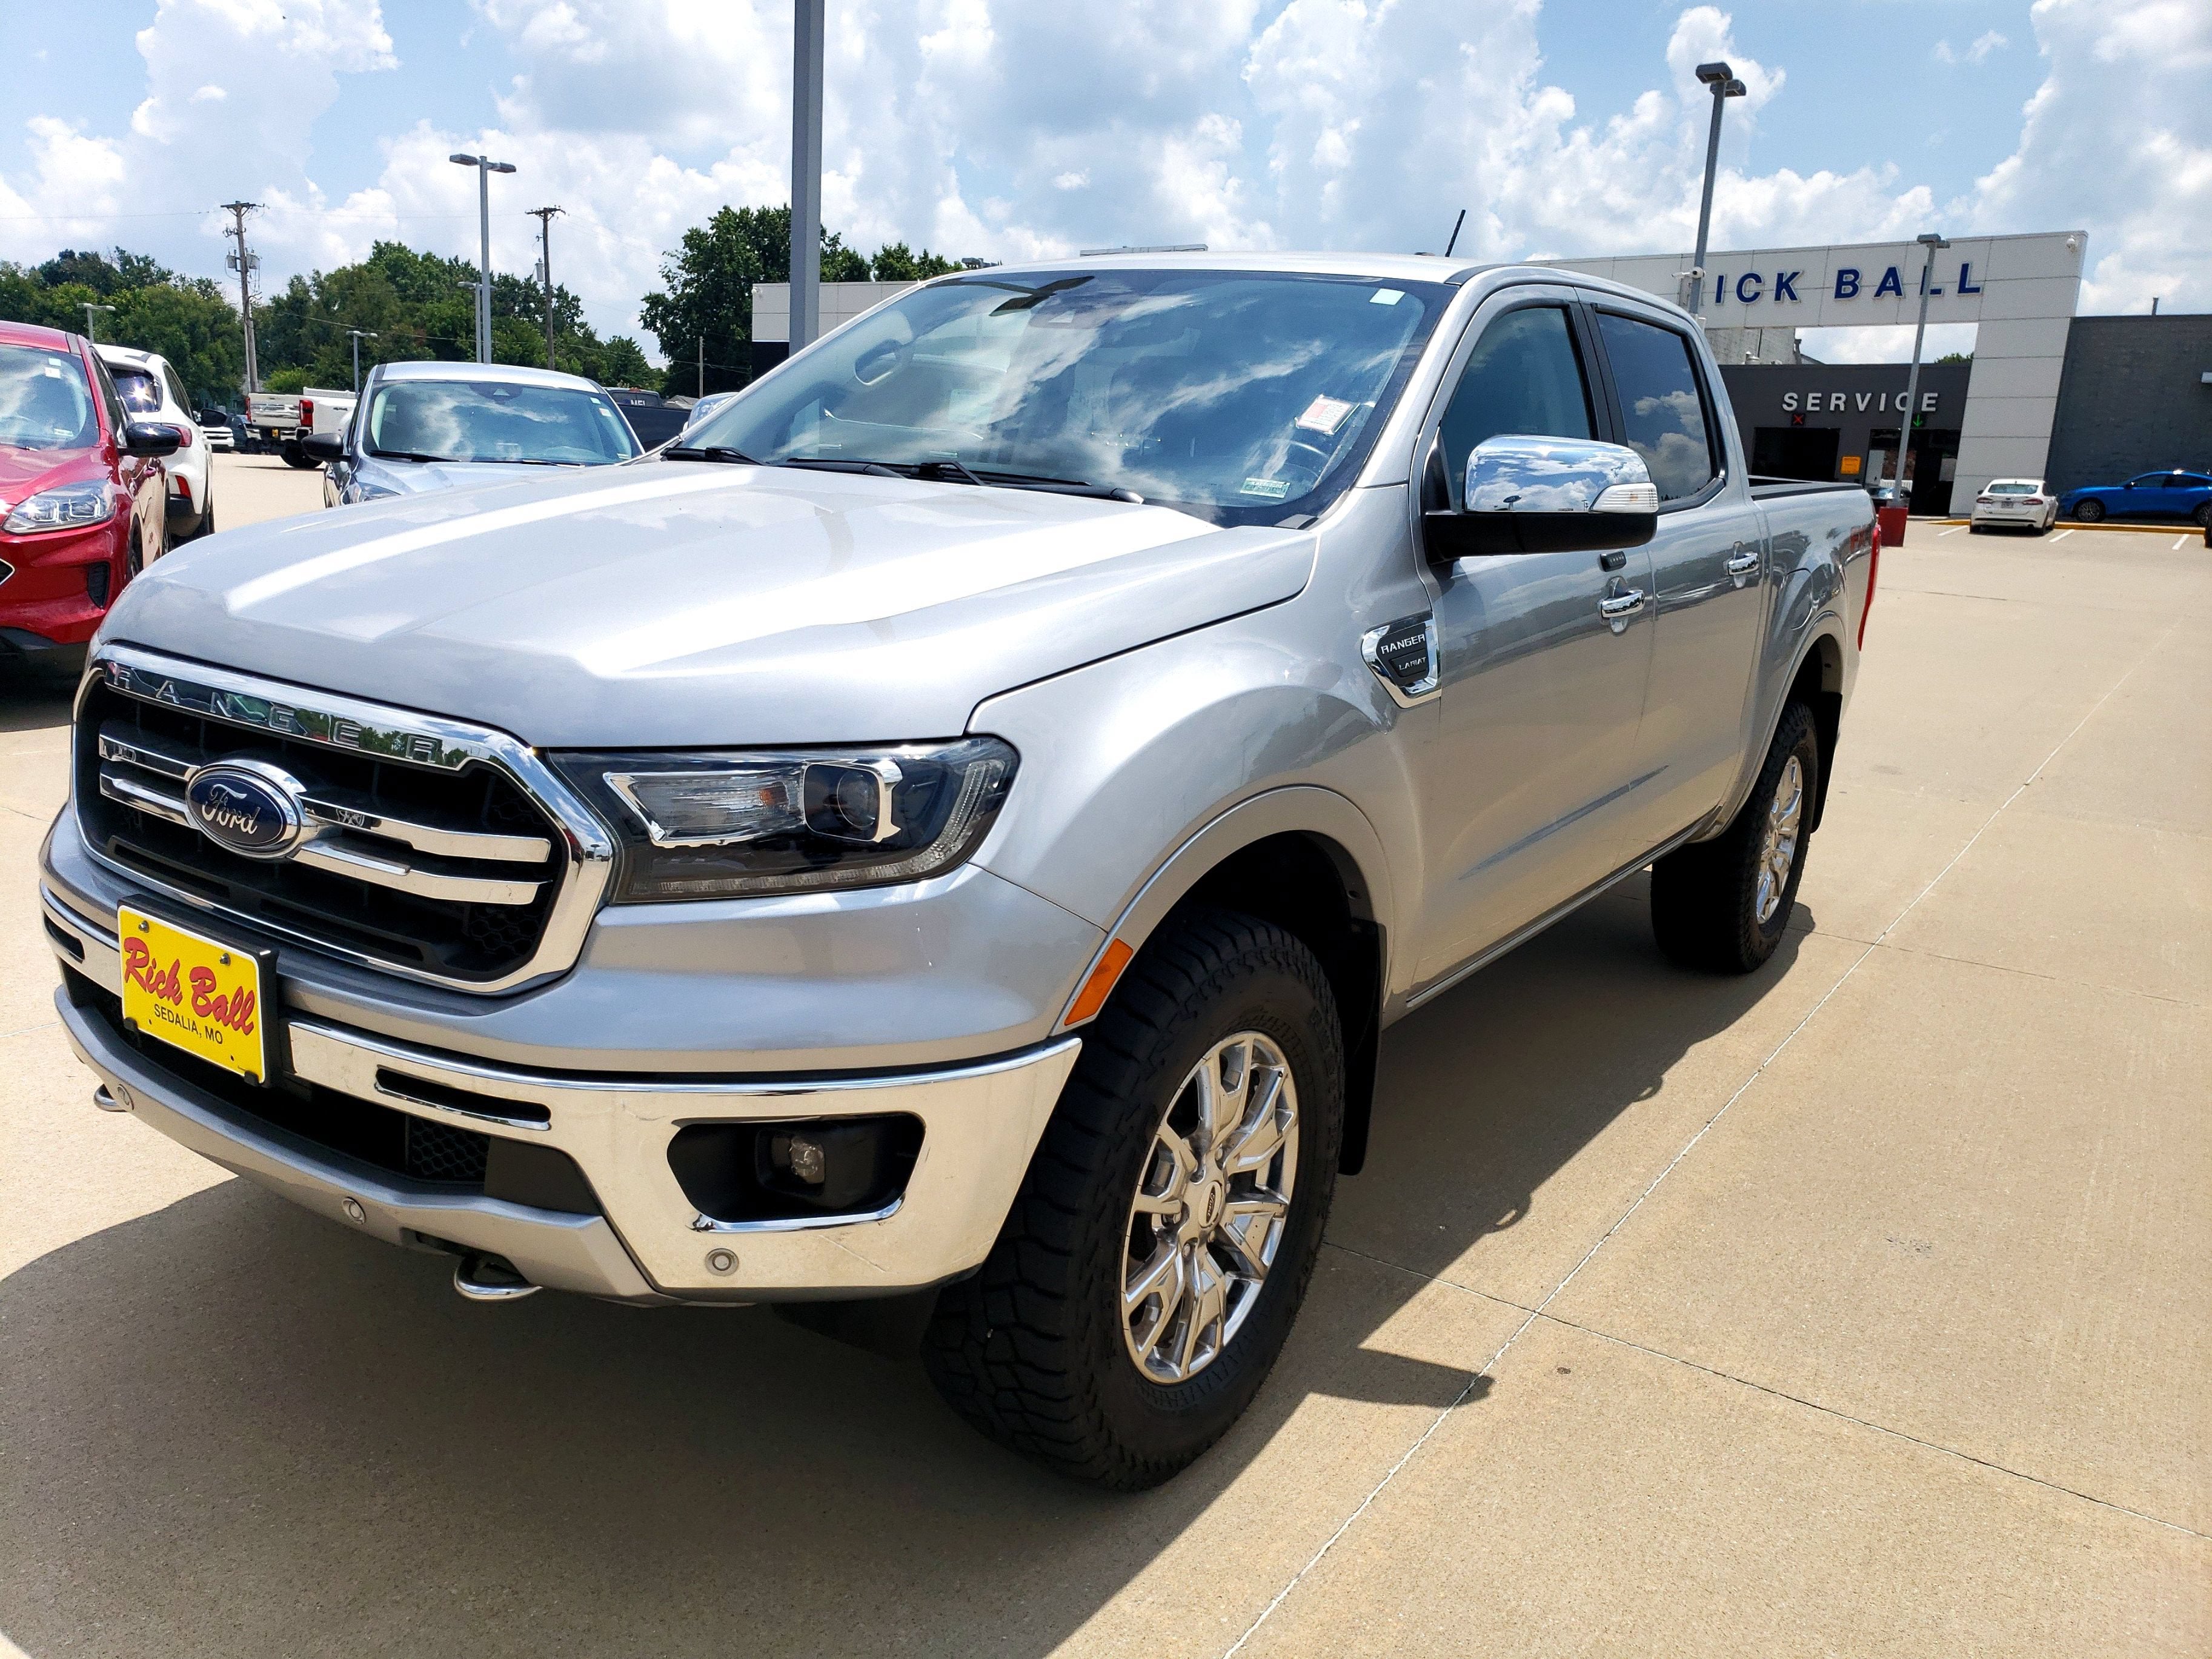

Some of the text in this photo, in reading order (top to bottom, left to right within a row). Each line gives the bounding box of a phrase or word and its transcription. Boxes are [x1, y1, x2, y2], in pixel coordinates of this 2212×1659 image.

[1700, 262, 1981, 304] ICK BALL
[1782, 392, 1938, 411] SERVICE
[1381, 634, 1426, 654] RANGER
[1399, 657, 1426, 671] LARIAT
[109, 662, 441, 765] RANGER
[202, 783, 261, 834] Ford
[124, 937, 255, 1036] Rick Ball
[154, 1003, 223, 1044] SEDALIA, MO
